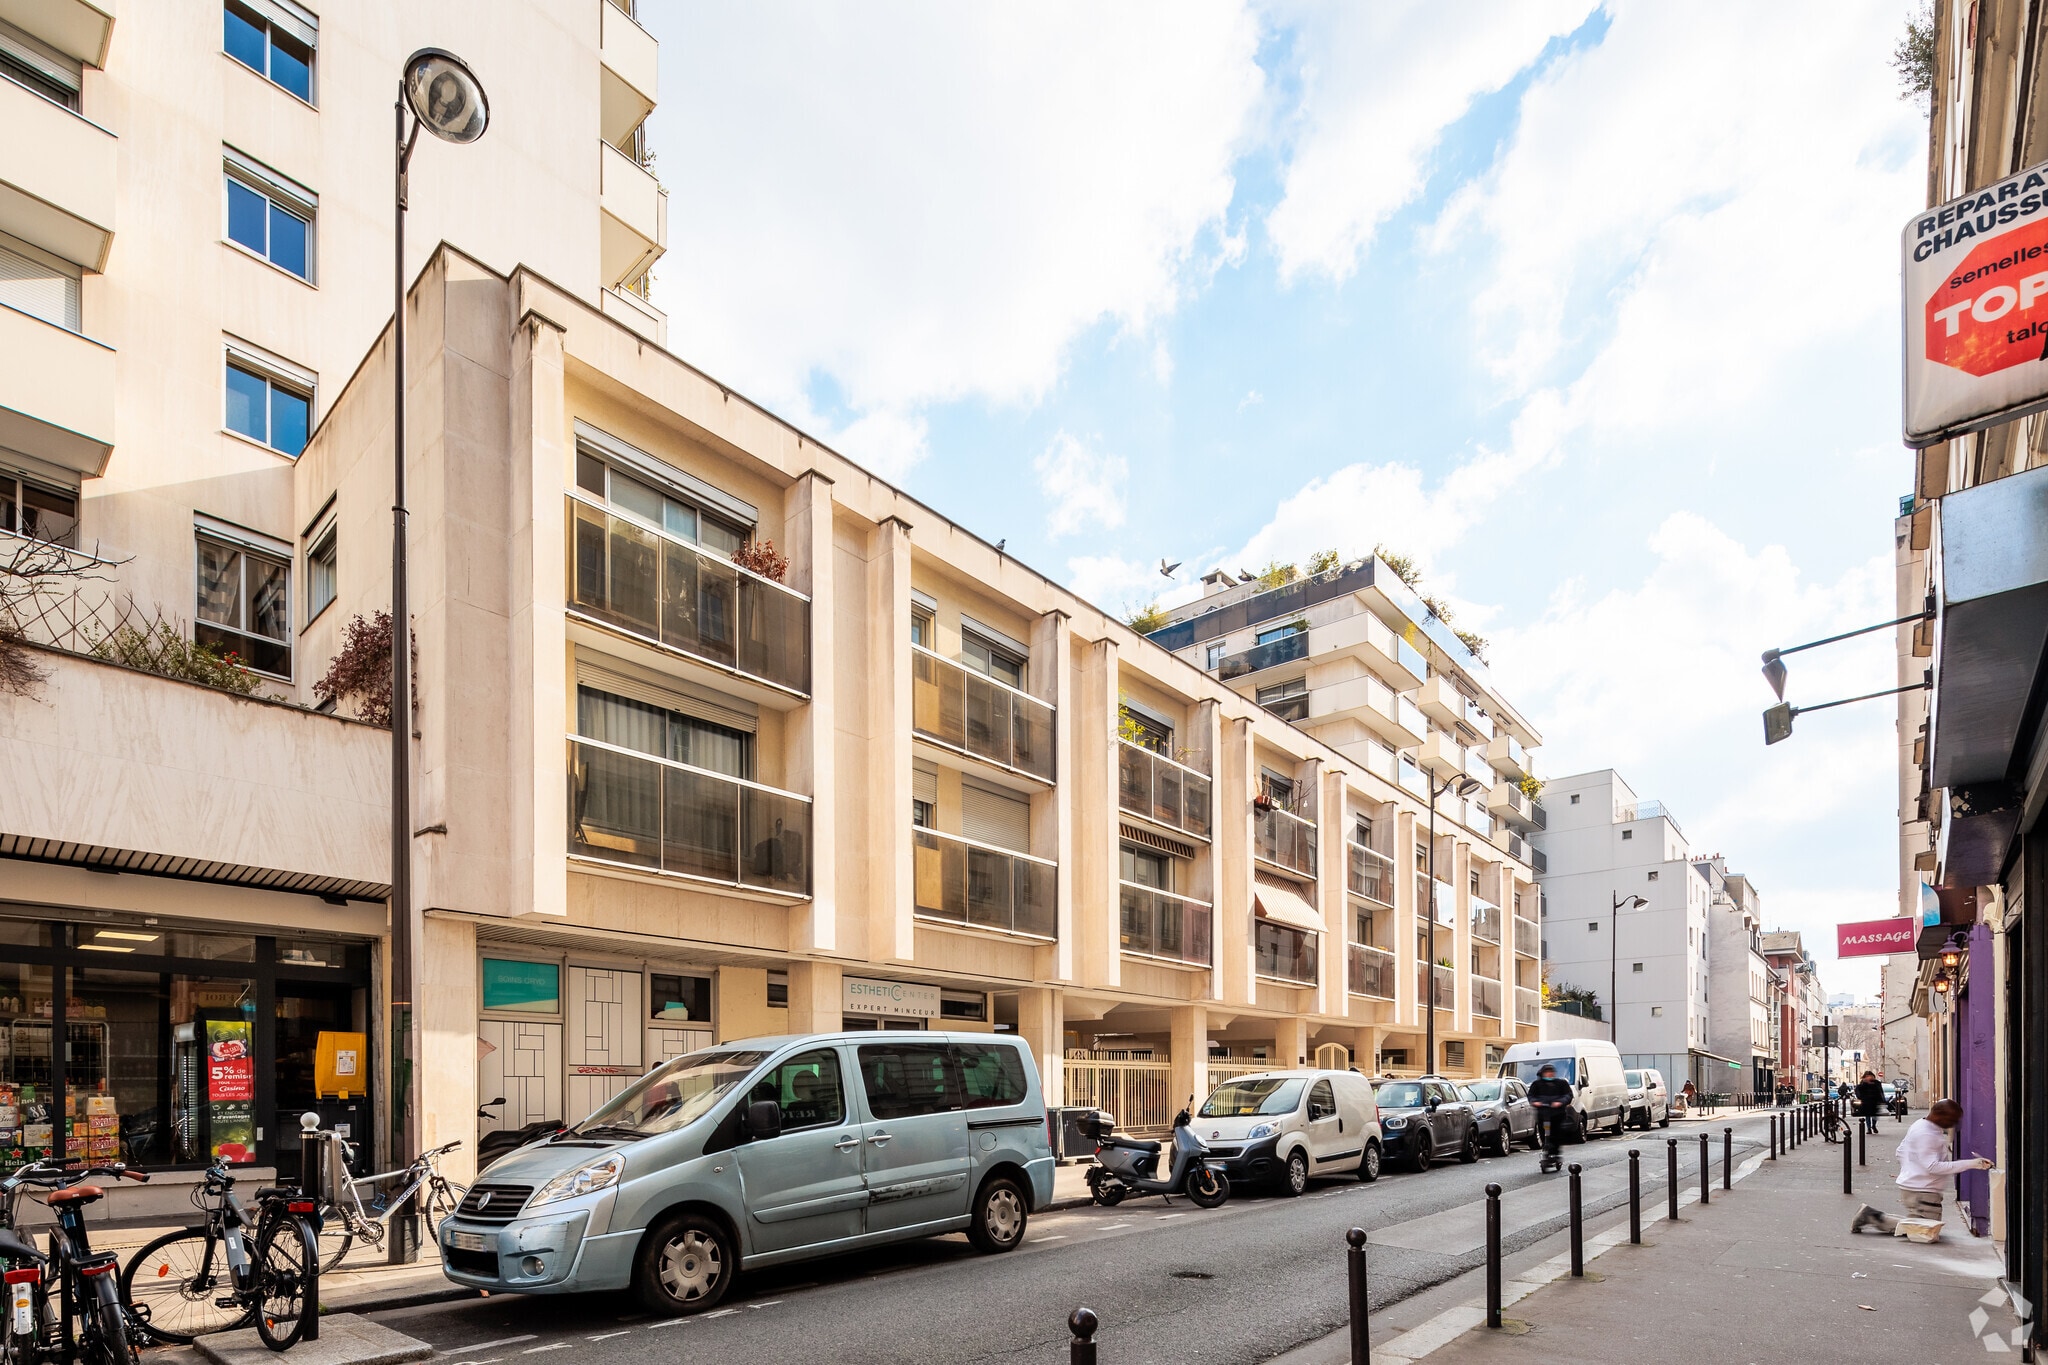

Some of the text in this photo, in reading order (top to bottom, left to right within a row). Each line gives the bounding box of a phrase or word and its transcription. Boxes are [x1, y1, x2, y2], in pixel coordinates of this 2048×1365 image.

[1917, 166, 2048, 240] REPARA
[1913, 190, 2048, 263] CHAUSS
[1842, 931, 1911, 946] MASSAGE
[498, 974, 522, 984] SOINS
[850, 1003, 935, 1016] EXPERT MINCEUR
[211, 1066, 234, 1080] 5%
[219, 1085, 246, 1093] Casino
